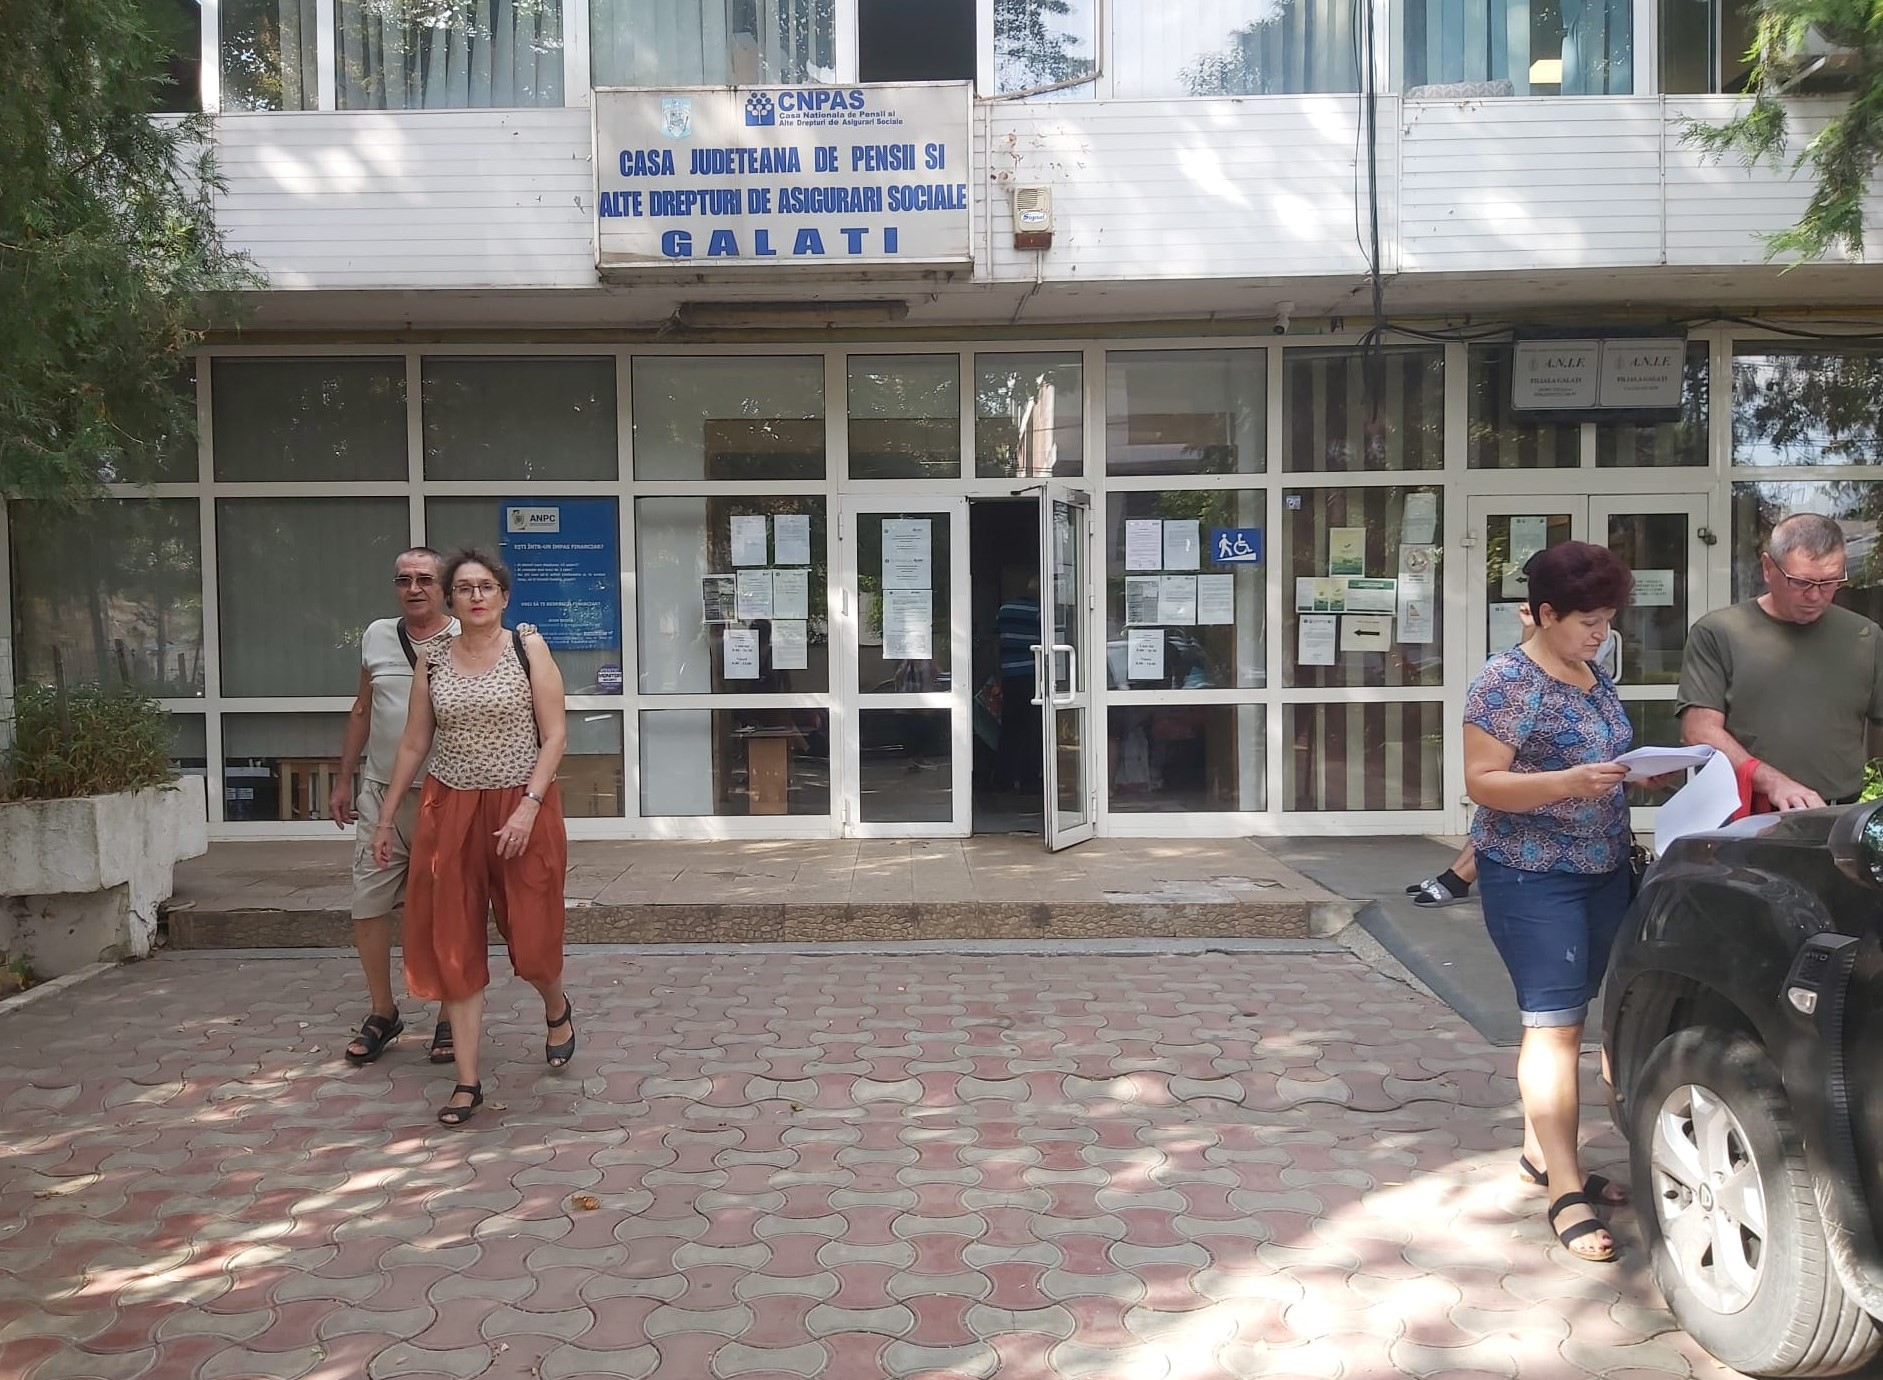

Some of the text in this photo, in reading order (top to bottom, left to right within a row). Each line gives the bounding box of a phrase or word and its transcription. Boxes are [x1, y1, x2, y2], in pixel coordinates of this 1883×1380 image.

[778, 90, 865, 111] CNPAS
[779, 112, 801, 120] Casa
[803, 111, 845, 119] Nationala
[859, 110, 886, 118] Pensii
[796, 119, 826, 127] Drepturi
[841, 118, 875, 127] Asigurari
[619, 143, 946, 177] CASA JUDETEANA DE PENSII SI
[600, 183, 967, 218] ALTE DREPTURI DE ASIGURARI SOCIALE
[661, 227, 898, 257] GALATI
[529, 514, 556, 523] ANPC
